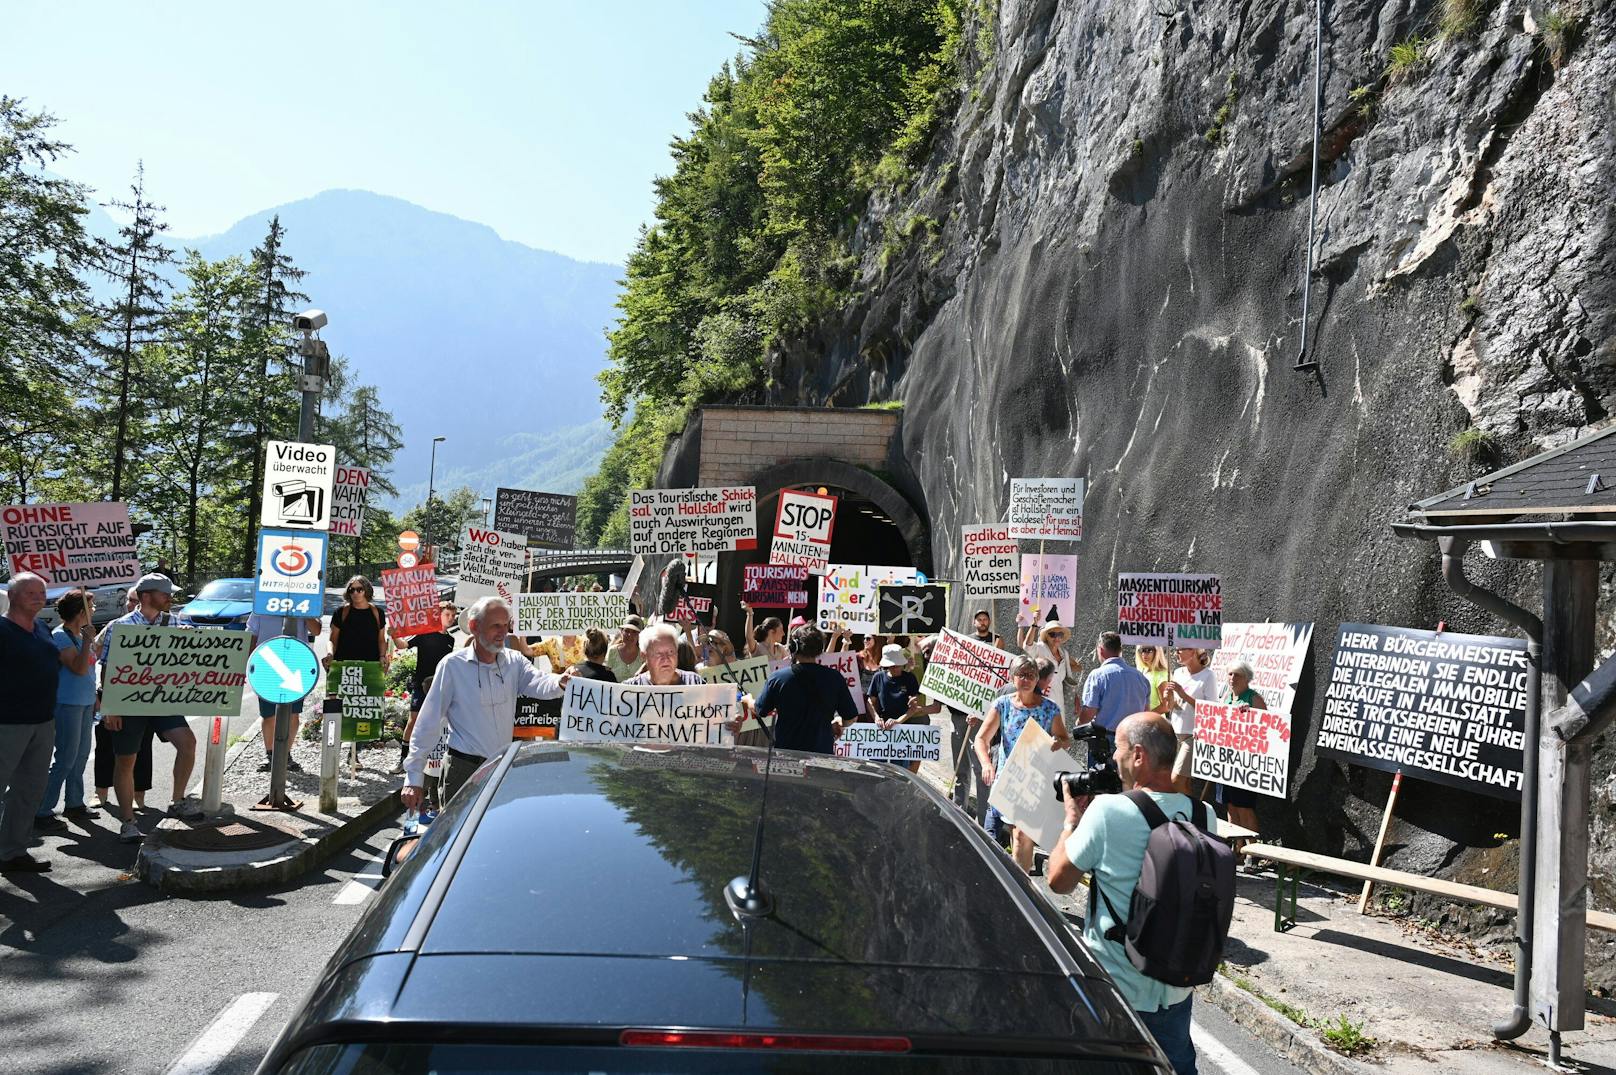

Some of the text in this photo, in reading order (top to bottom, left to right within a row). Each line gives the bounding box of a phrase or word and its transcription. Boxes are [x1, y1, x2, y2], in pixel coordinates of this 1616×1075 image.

[276, 445, 327, 463] Video
[273, 462, 327, 476] überwacht
[336, 467, 370, 487] DEN
[632, 488, 758, 504] Das touristische Schick-
[1013, 483, 1076, 494] Für Investoren und
[1012, 493, 1077, 504] Geschäftemacher
[3, 506, 73, 524] OHNE
[330, 504, 363, 520] acht
[632, 501, 752, 517] sal von Hallstatt wird
[781, 503, 832, 530] STOP
[1021, 503, 1051, 514] Hallstatt
[1066, 505, 1079, 514] ein
[633, 515, 744, 530] auch Auswirkungen
[1046, 513, 1082, 526] für uns ist
[7, 521, 125, 540] RÜCKSICHT AUF
[634, 525, 755, 542] auf andere Regionen
[964, 527, 1018, 541] radikal
[1011, 523, 1082, 537] es aber die Heimat
[5, 535, 136, 554] DIE BEVÖLKERUNG
[468, 528, 500, 546] WO
[501, 538, 527, 551] haben
[634, 539, 728, 554] und Orte haben
[964, 542, 1019, 555] Grenzen
[465, 543, 482, 553] sich
[484, 546, 497, 556] die
[773, 541, 822, 557] MINUTEN
[12, 551, 66, 577] KEIN
[463, 552, 502, 567] steckt die
[771, 552, 828, 570] HALLSTATT
[965, 555, 1012, 569] für den
[49, 564, 135, 583] TOURISMUS
[381, 569, 437, 586] WARUM
[463, 560, 524, 581] Weltkulturerbe
[744, 566, 808, 581] TOURISMUS
[823, 568, 860, 591] Kind
[966, 569, 1019, 582] Massen
[262, 580, 305, 589] HITRADIO
[460, 573, 495, 587] schützen
[965, 582, 1021, 595] tourismus
[1118, 577, 1222, 594] MASSENTOURISMUS
[385, 582, 439, 601] SCHAUEN
[787, 591, 808, 604] NEIN
[821, 587, 866, 605] in der
[266, 597, 311, 614] 89.4
[386, 593, 441, 615] SO VIELE
[518, 595, 599, 607] HALLSTATT IST DER
[1119, 592, 1223, 610] IST SCHONUNGSLOSE
[388, 610, 430, 630] WEG
[519, 606, 541, 618] BOTE
[547, 606, 564, 618] DER
[1119, 606, 1196, 624] AUSBEUTUNG
[518, 619, 532, 631] EN
[1118, 621, 1223, 647] MENSCH UND NATUR
[120, 627, 244, 651] wir müssen
[1240, 624, 1288, 653] fordern
[936, 640, 995, 675] WIR BRAUCHEN
[942, 632, 1006, 667] WIR BRAUCHEN
[1340, 632, 1529, 669] HERR BÜRGERMEISTER
[133, 652, 230, 670] unseren
[932, 652, 993, 686] WIR BRAUCHEN
[110, 664, 247, 687] Lebensraum
[341, 675, 363, 685] BIN
[342, 666, 363, 677] ICH
[1335, 650, 1528, 693] UNTERBINDEN SIE ENDLIC
[927, 662, 999, 703] WIR BRAUCHEN
[1331, 666, 1354, 684] DIE
[1355, 668, 1431, 696] ILLEGALEN
[121, 684, 229, 705] schützen
[338, 685, 368, 696] KEIN
[341, 696, 384, 707] ASSEN
[521, 702, 539, 714] mit
[570, 684, 684, 719] HALLSTATT
[674, 703, 733, 720] GEHÖRT
[1324, 682, 1513, 729] AUFKÄUFE IN HALLSTATT.
[342, 707, 383, 719] URIST
[1324, 698, 1359, 720] DIESE
[1362, 704, 1463, 739] TRICKSEREIEN
[567, 714, 594, 733] DER
[1195, 703, 1292, 744] KEINE ZEIT MEHR
[1195, 714, 1269, 741] FÜR BILLIGE
[1197, 729, 1270, 755] AUSREDEN
[1322, 714, 1480, 761] DIREKT IN EINE NEUE
[1195, 742, 1285, 776] WIR BRAUCHEN
[1316, 730, 1526, 792] ZWEIKLASSENGESELLSCHAFT
[1193, 757, 1285, 795] LÖSUNGEN
